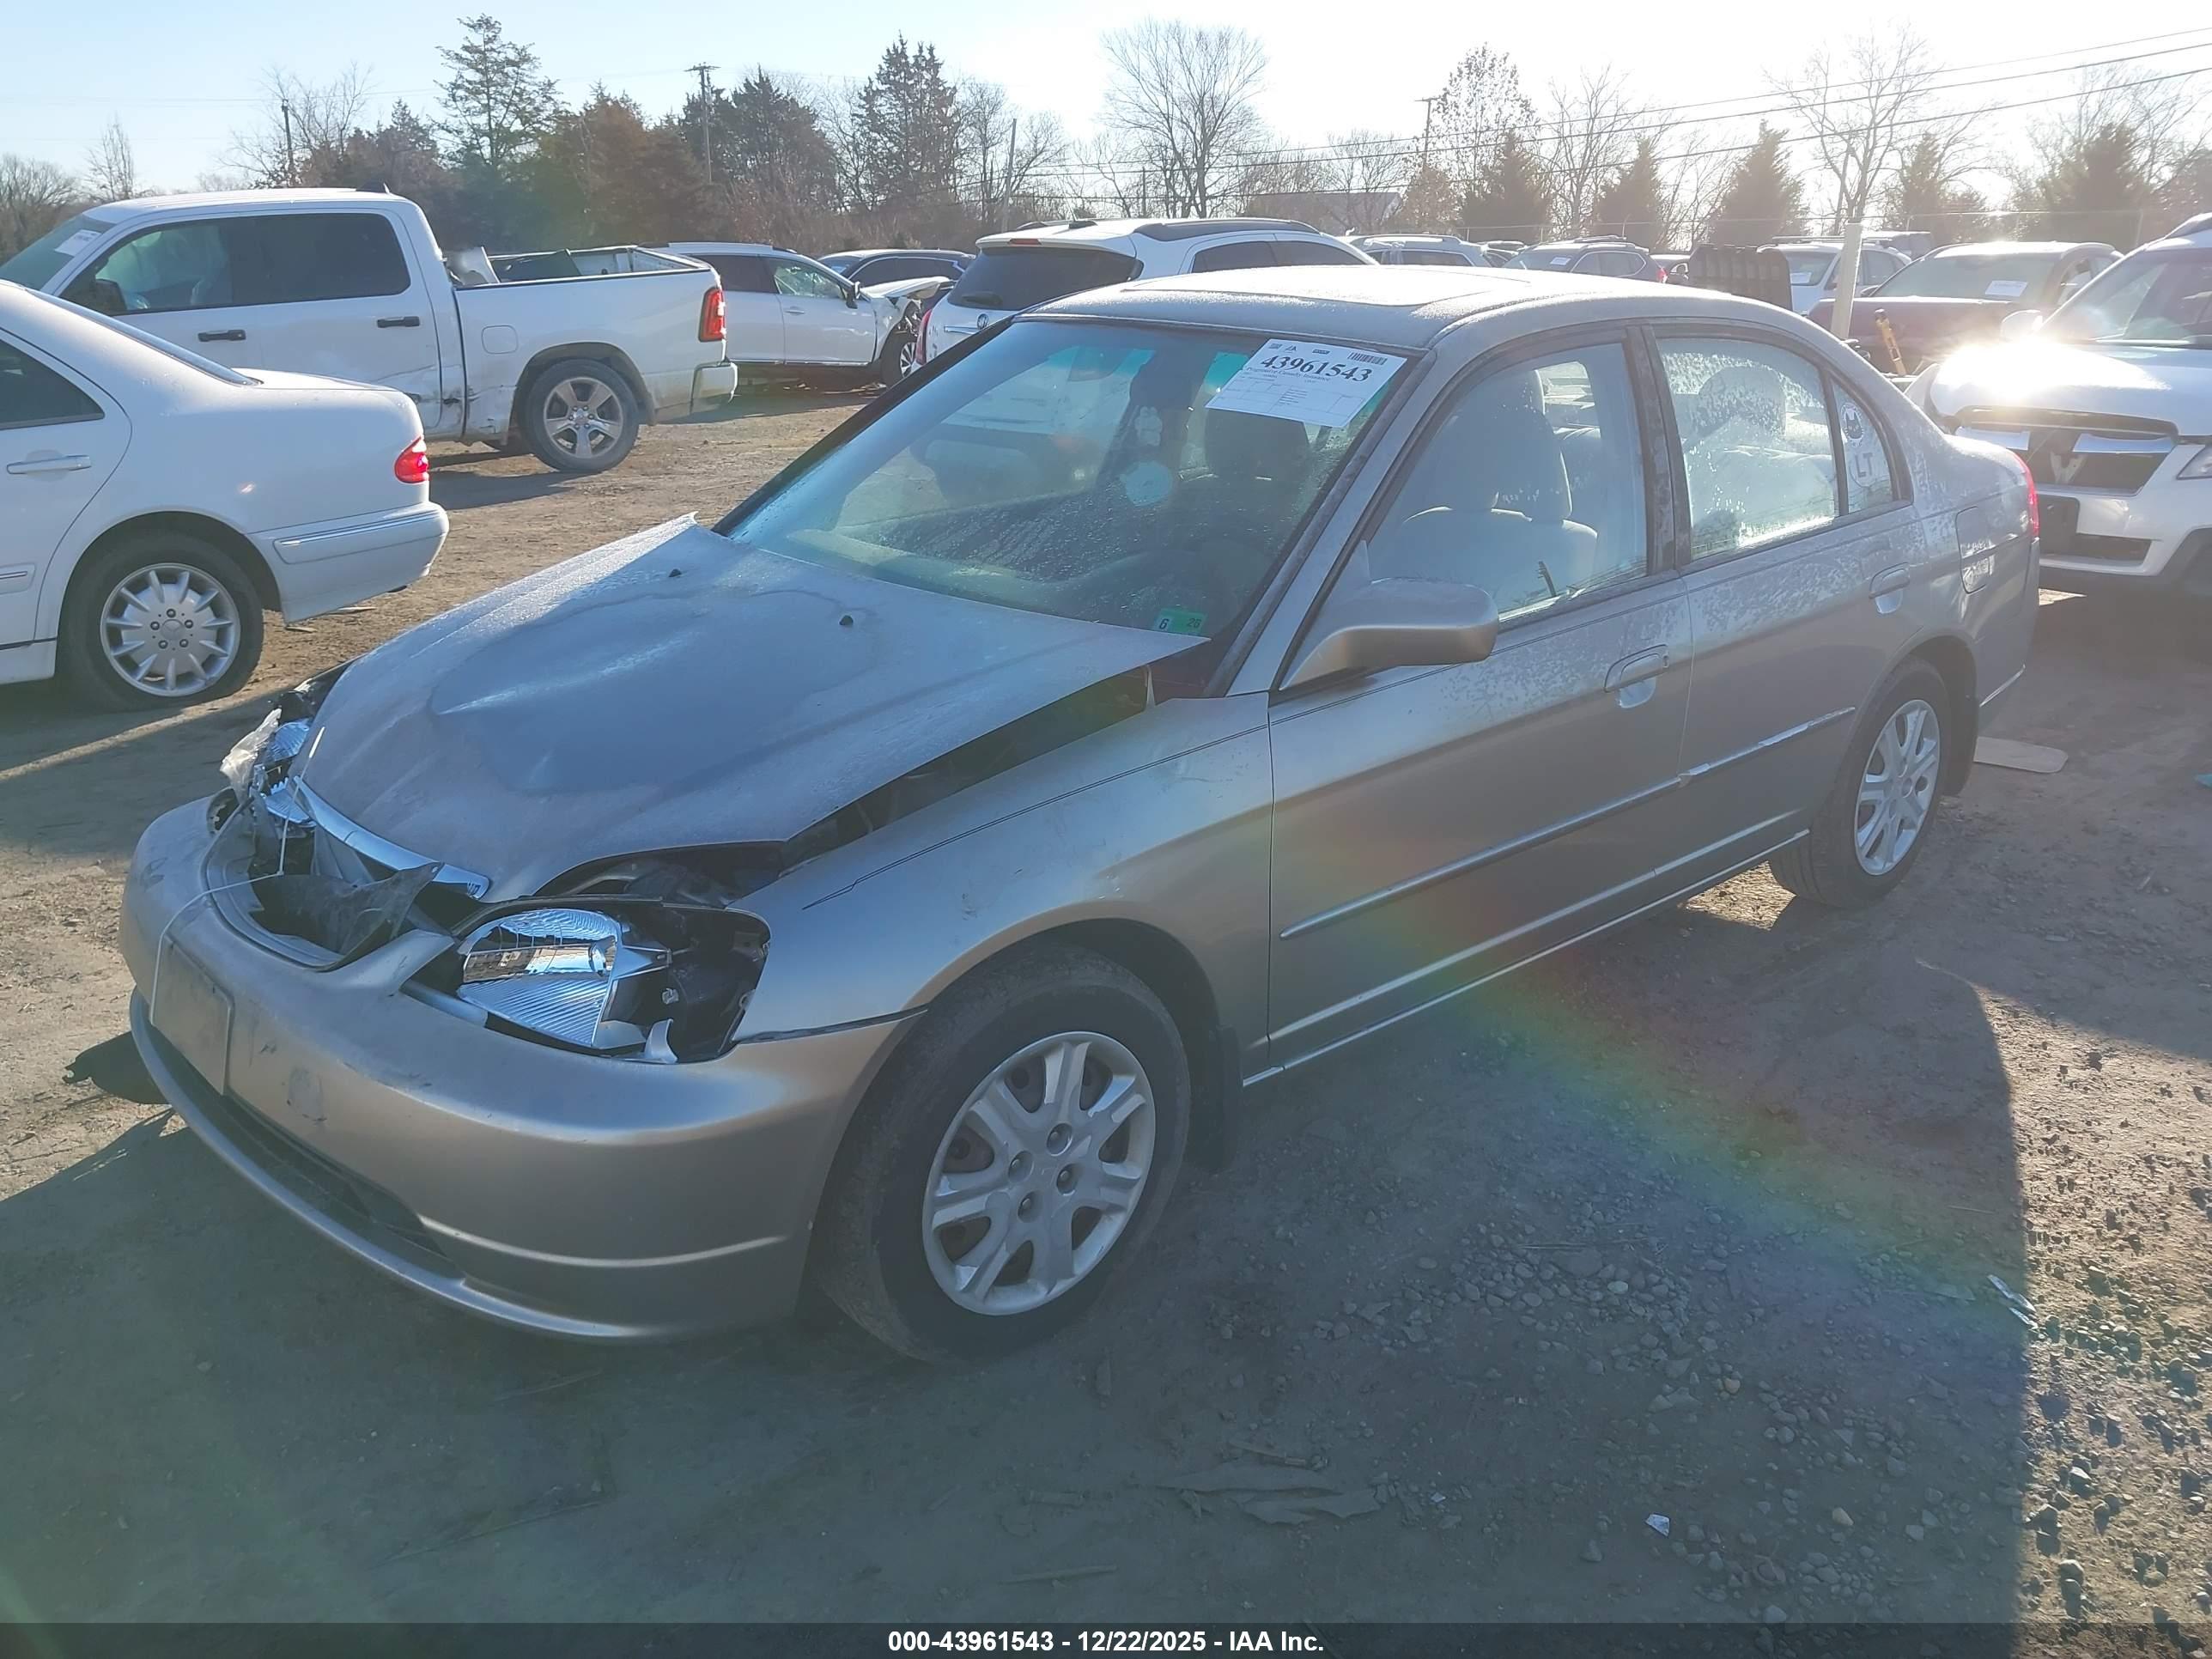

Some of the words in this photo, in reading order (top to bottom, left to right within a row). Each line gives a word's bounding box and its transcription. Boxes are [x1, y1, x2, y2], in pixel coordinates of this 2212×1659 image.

[1261, 355, 1373, 382] 43961543
[1855, 452, 1874, 477] LT
[1159, 618, 1170, 629] 6
